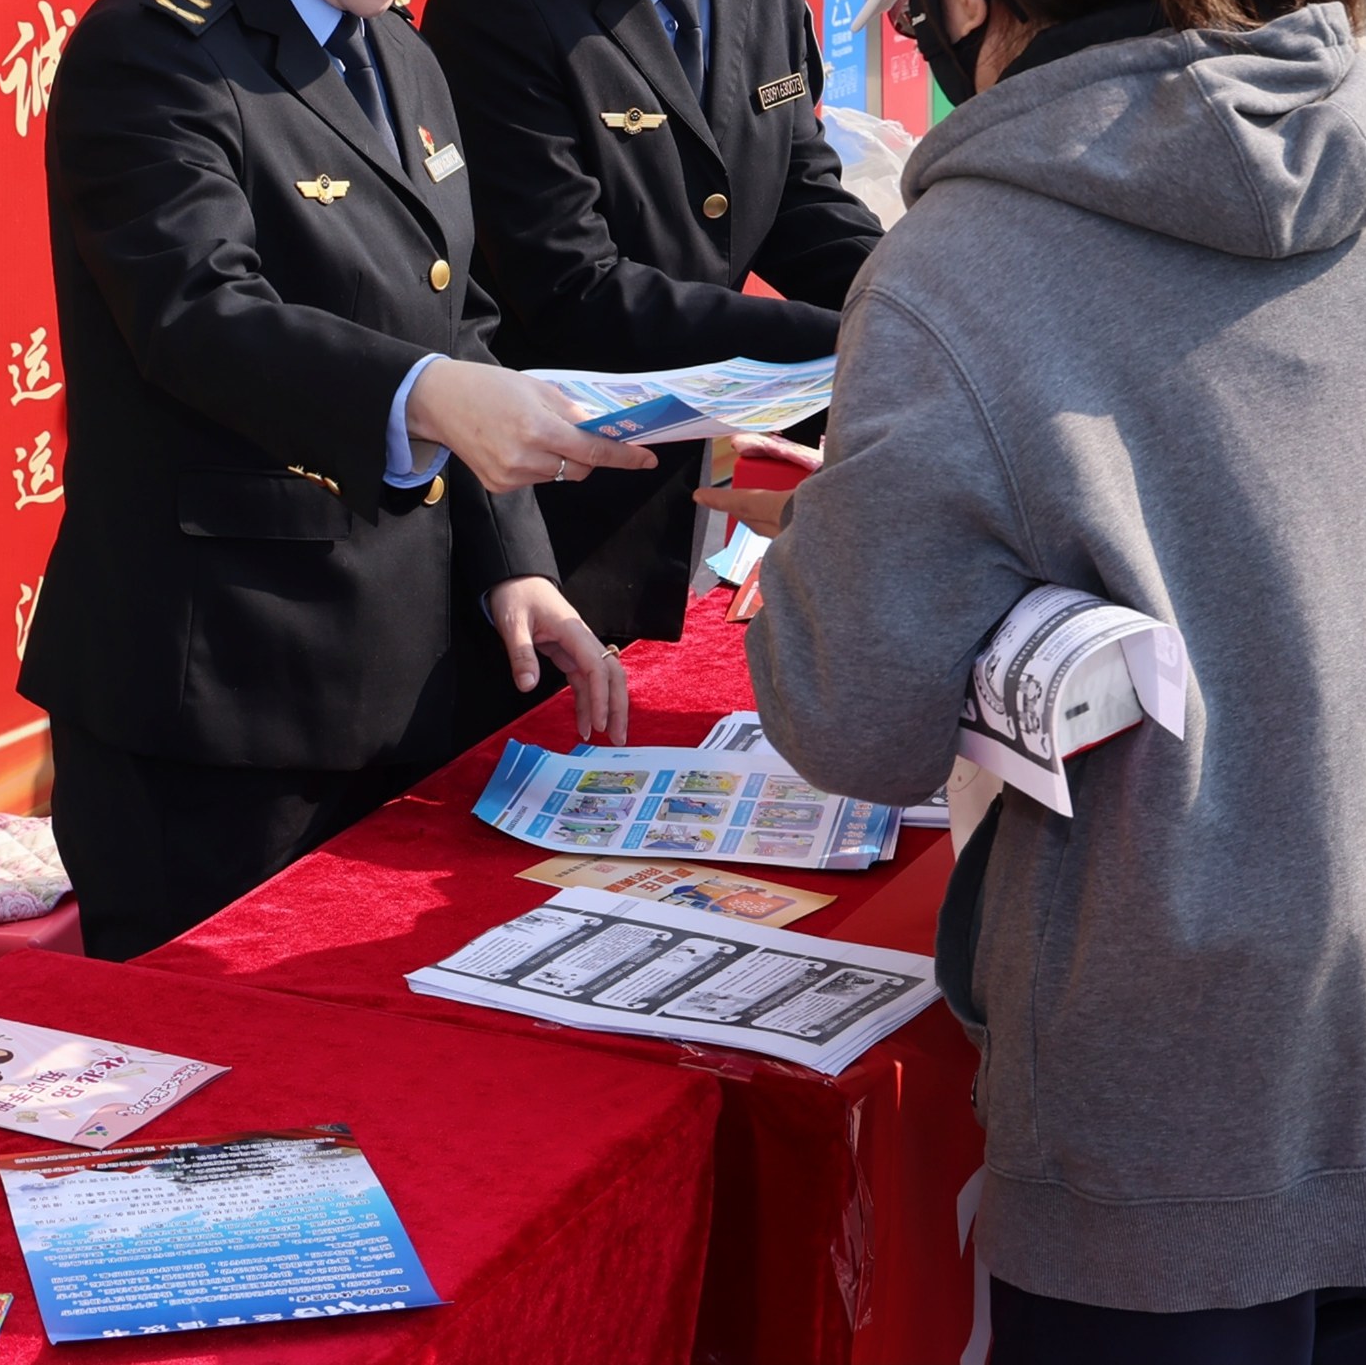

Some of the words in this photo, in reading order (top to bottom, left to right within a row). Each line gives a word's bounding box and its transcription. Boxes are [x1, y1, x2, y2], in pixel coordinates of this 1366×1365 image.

[760, 76, 804, 107] 03091630073
[49, 1057, 133, 1100] 化妆品
